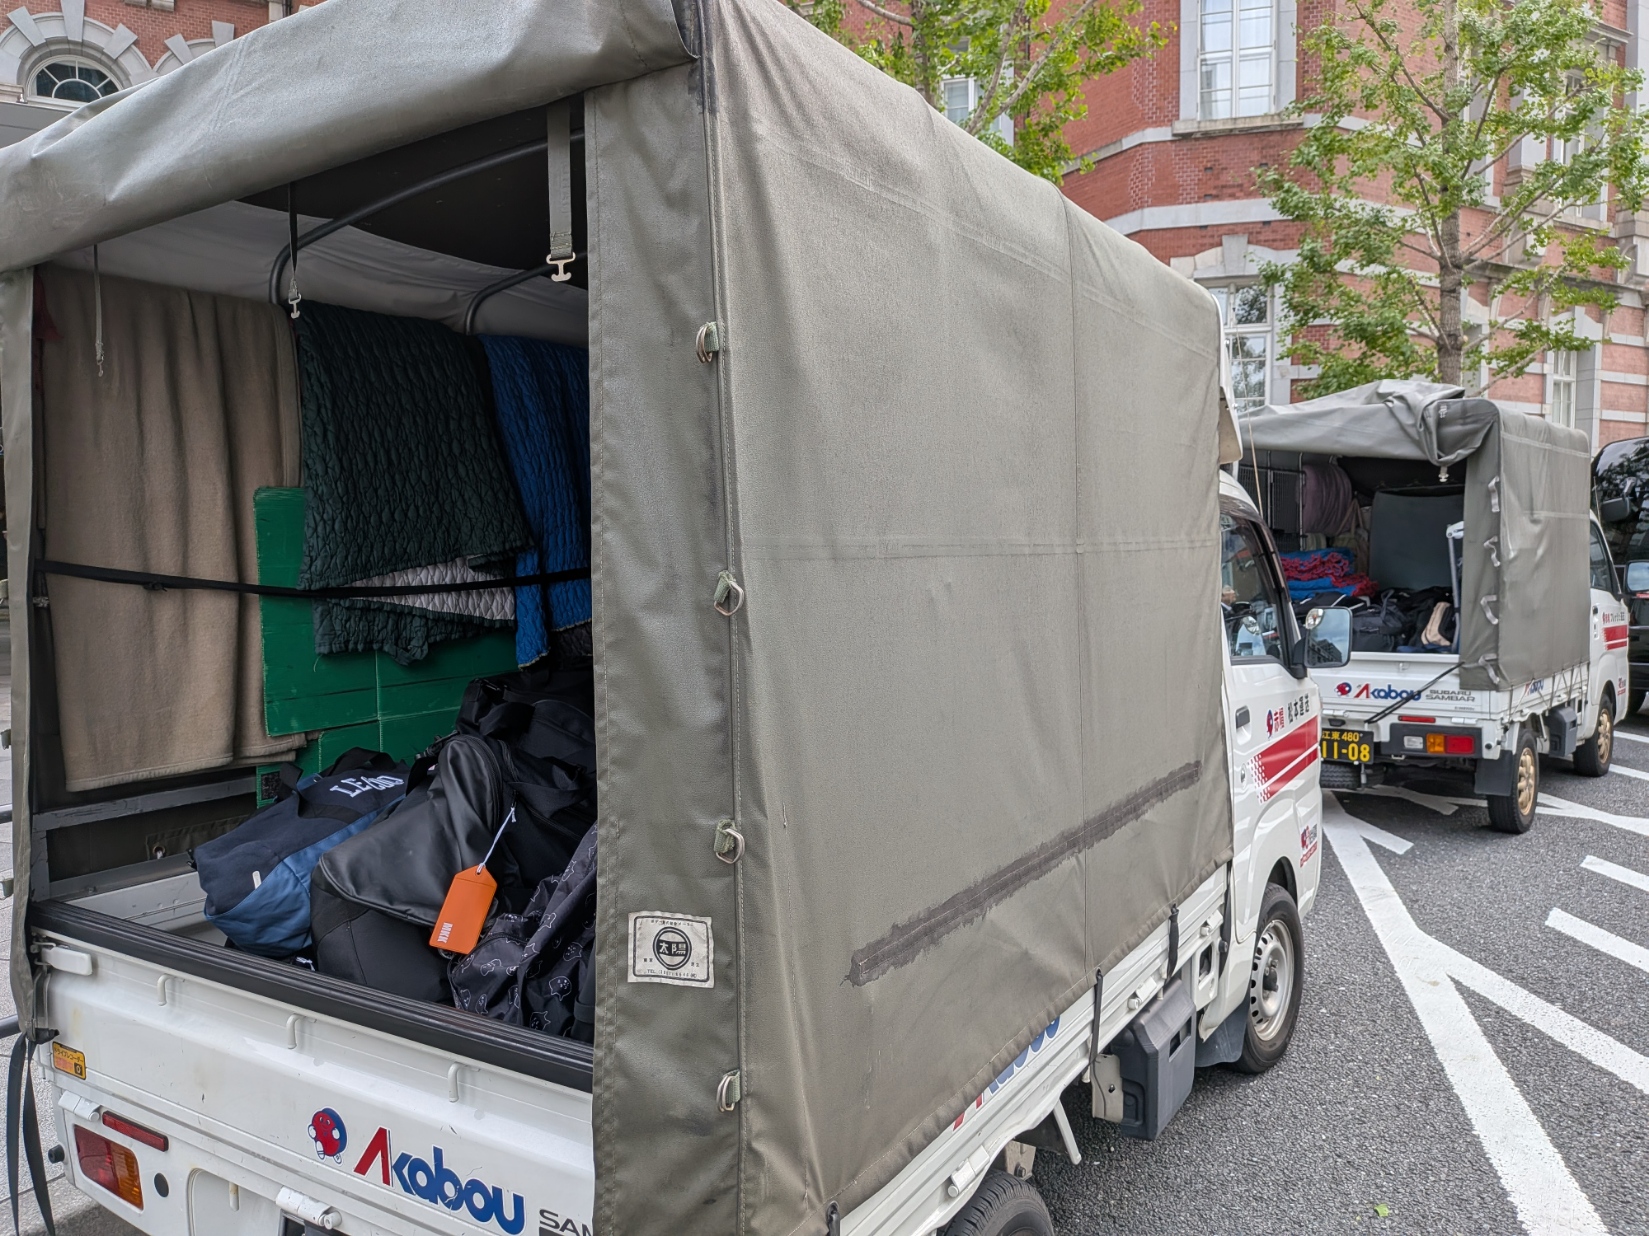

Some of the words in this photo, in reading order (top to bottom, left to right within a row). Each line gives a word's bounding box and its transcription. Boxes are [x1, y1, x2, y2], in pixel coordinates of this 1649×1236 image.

[1425, 694, 1475, 703] SAMBAR
[1321, 731, 1341, 741] 江東
[1341, 731, 1360, 742] 480
[1322, 740, 1370, 762] 11-08
[659, 942, 686, 955] 太陽
[353, 1126, 525, 1235] Akabou
